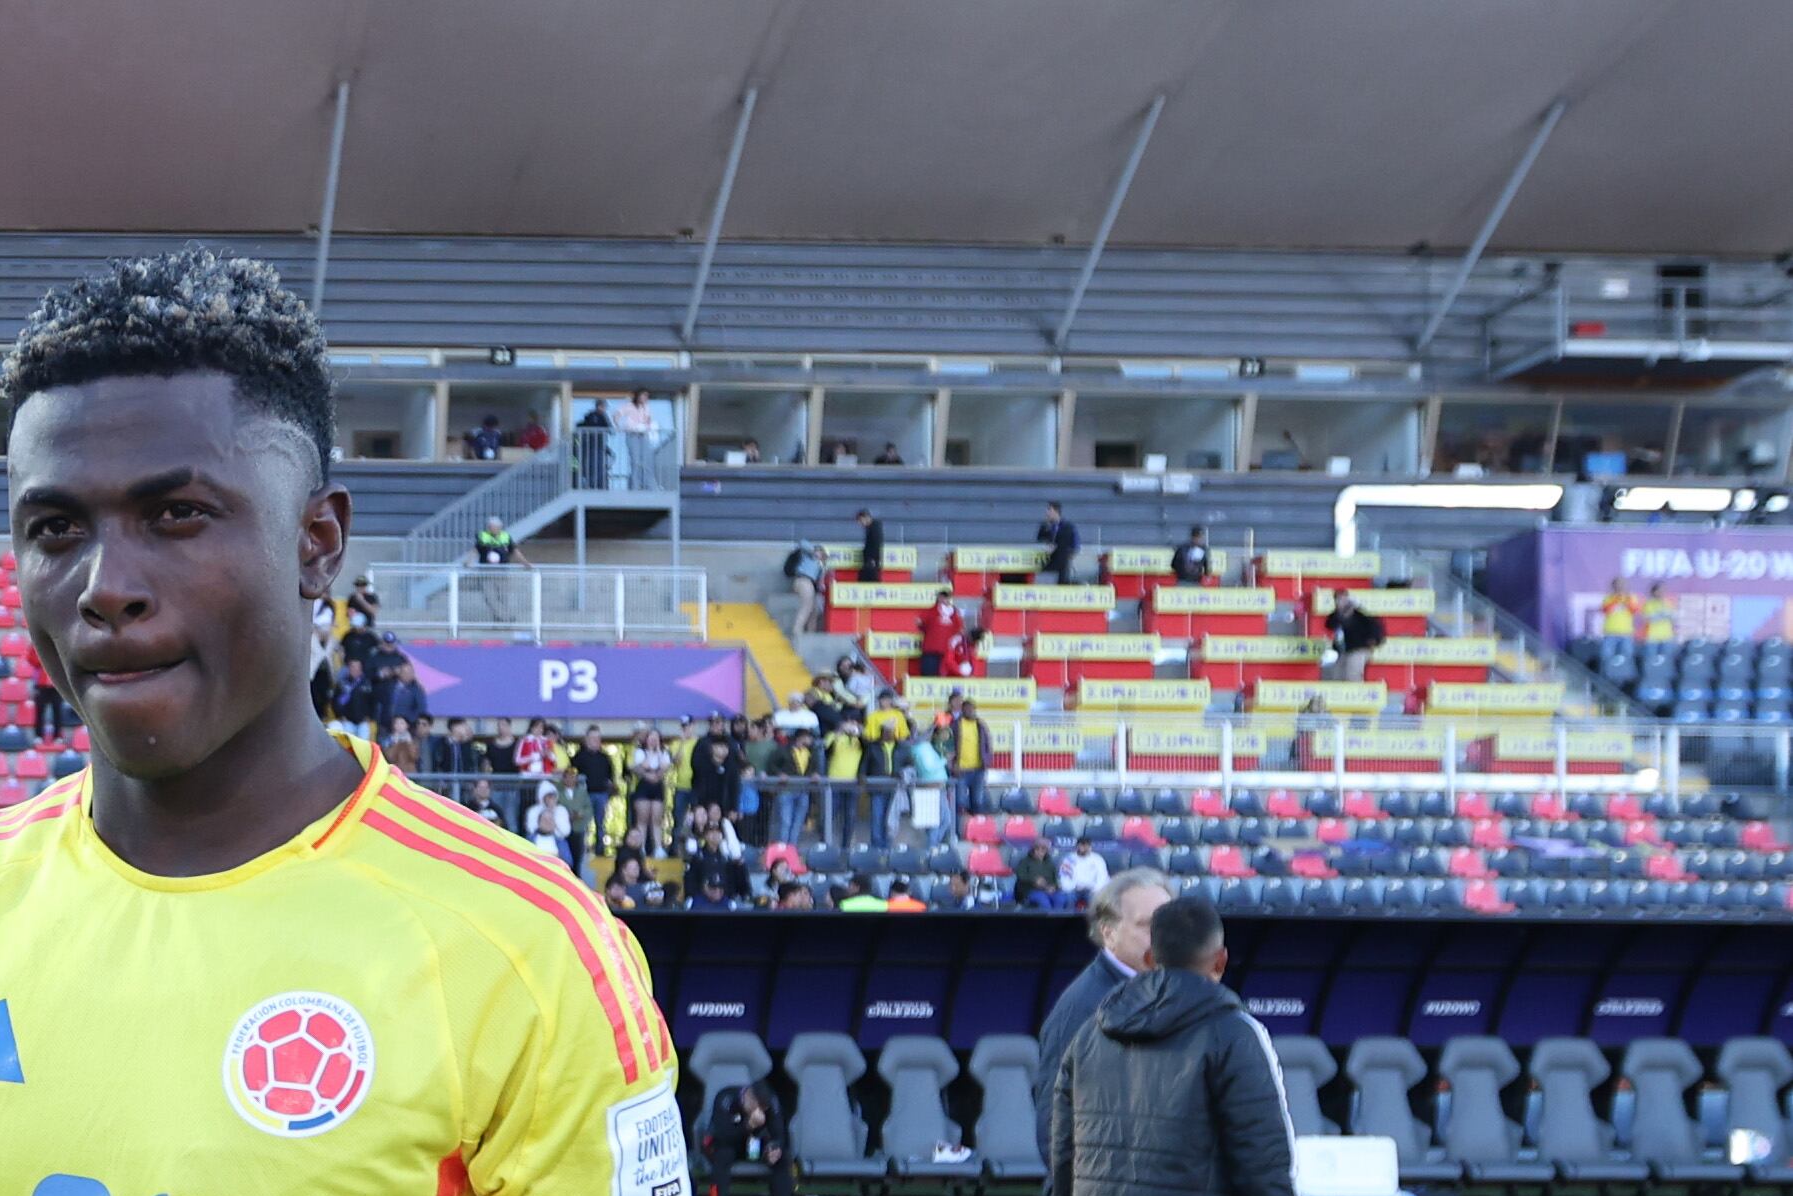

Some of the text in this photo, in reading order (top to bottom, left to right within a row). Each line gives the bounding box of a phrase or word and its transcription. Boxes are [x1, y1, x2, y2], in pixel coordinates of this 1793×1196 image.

[1621, 547, 1694, 578] FIFA
[1696, 548, 1768, 581] U-20
[539, 659, 599, 704] P3
[279, 996, 346, 1018] COLOMBIANA
[343, 1013, 357, 1027] DE
[688, 1003, 746, 1017] #U20WC
